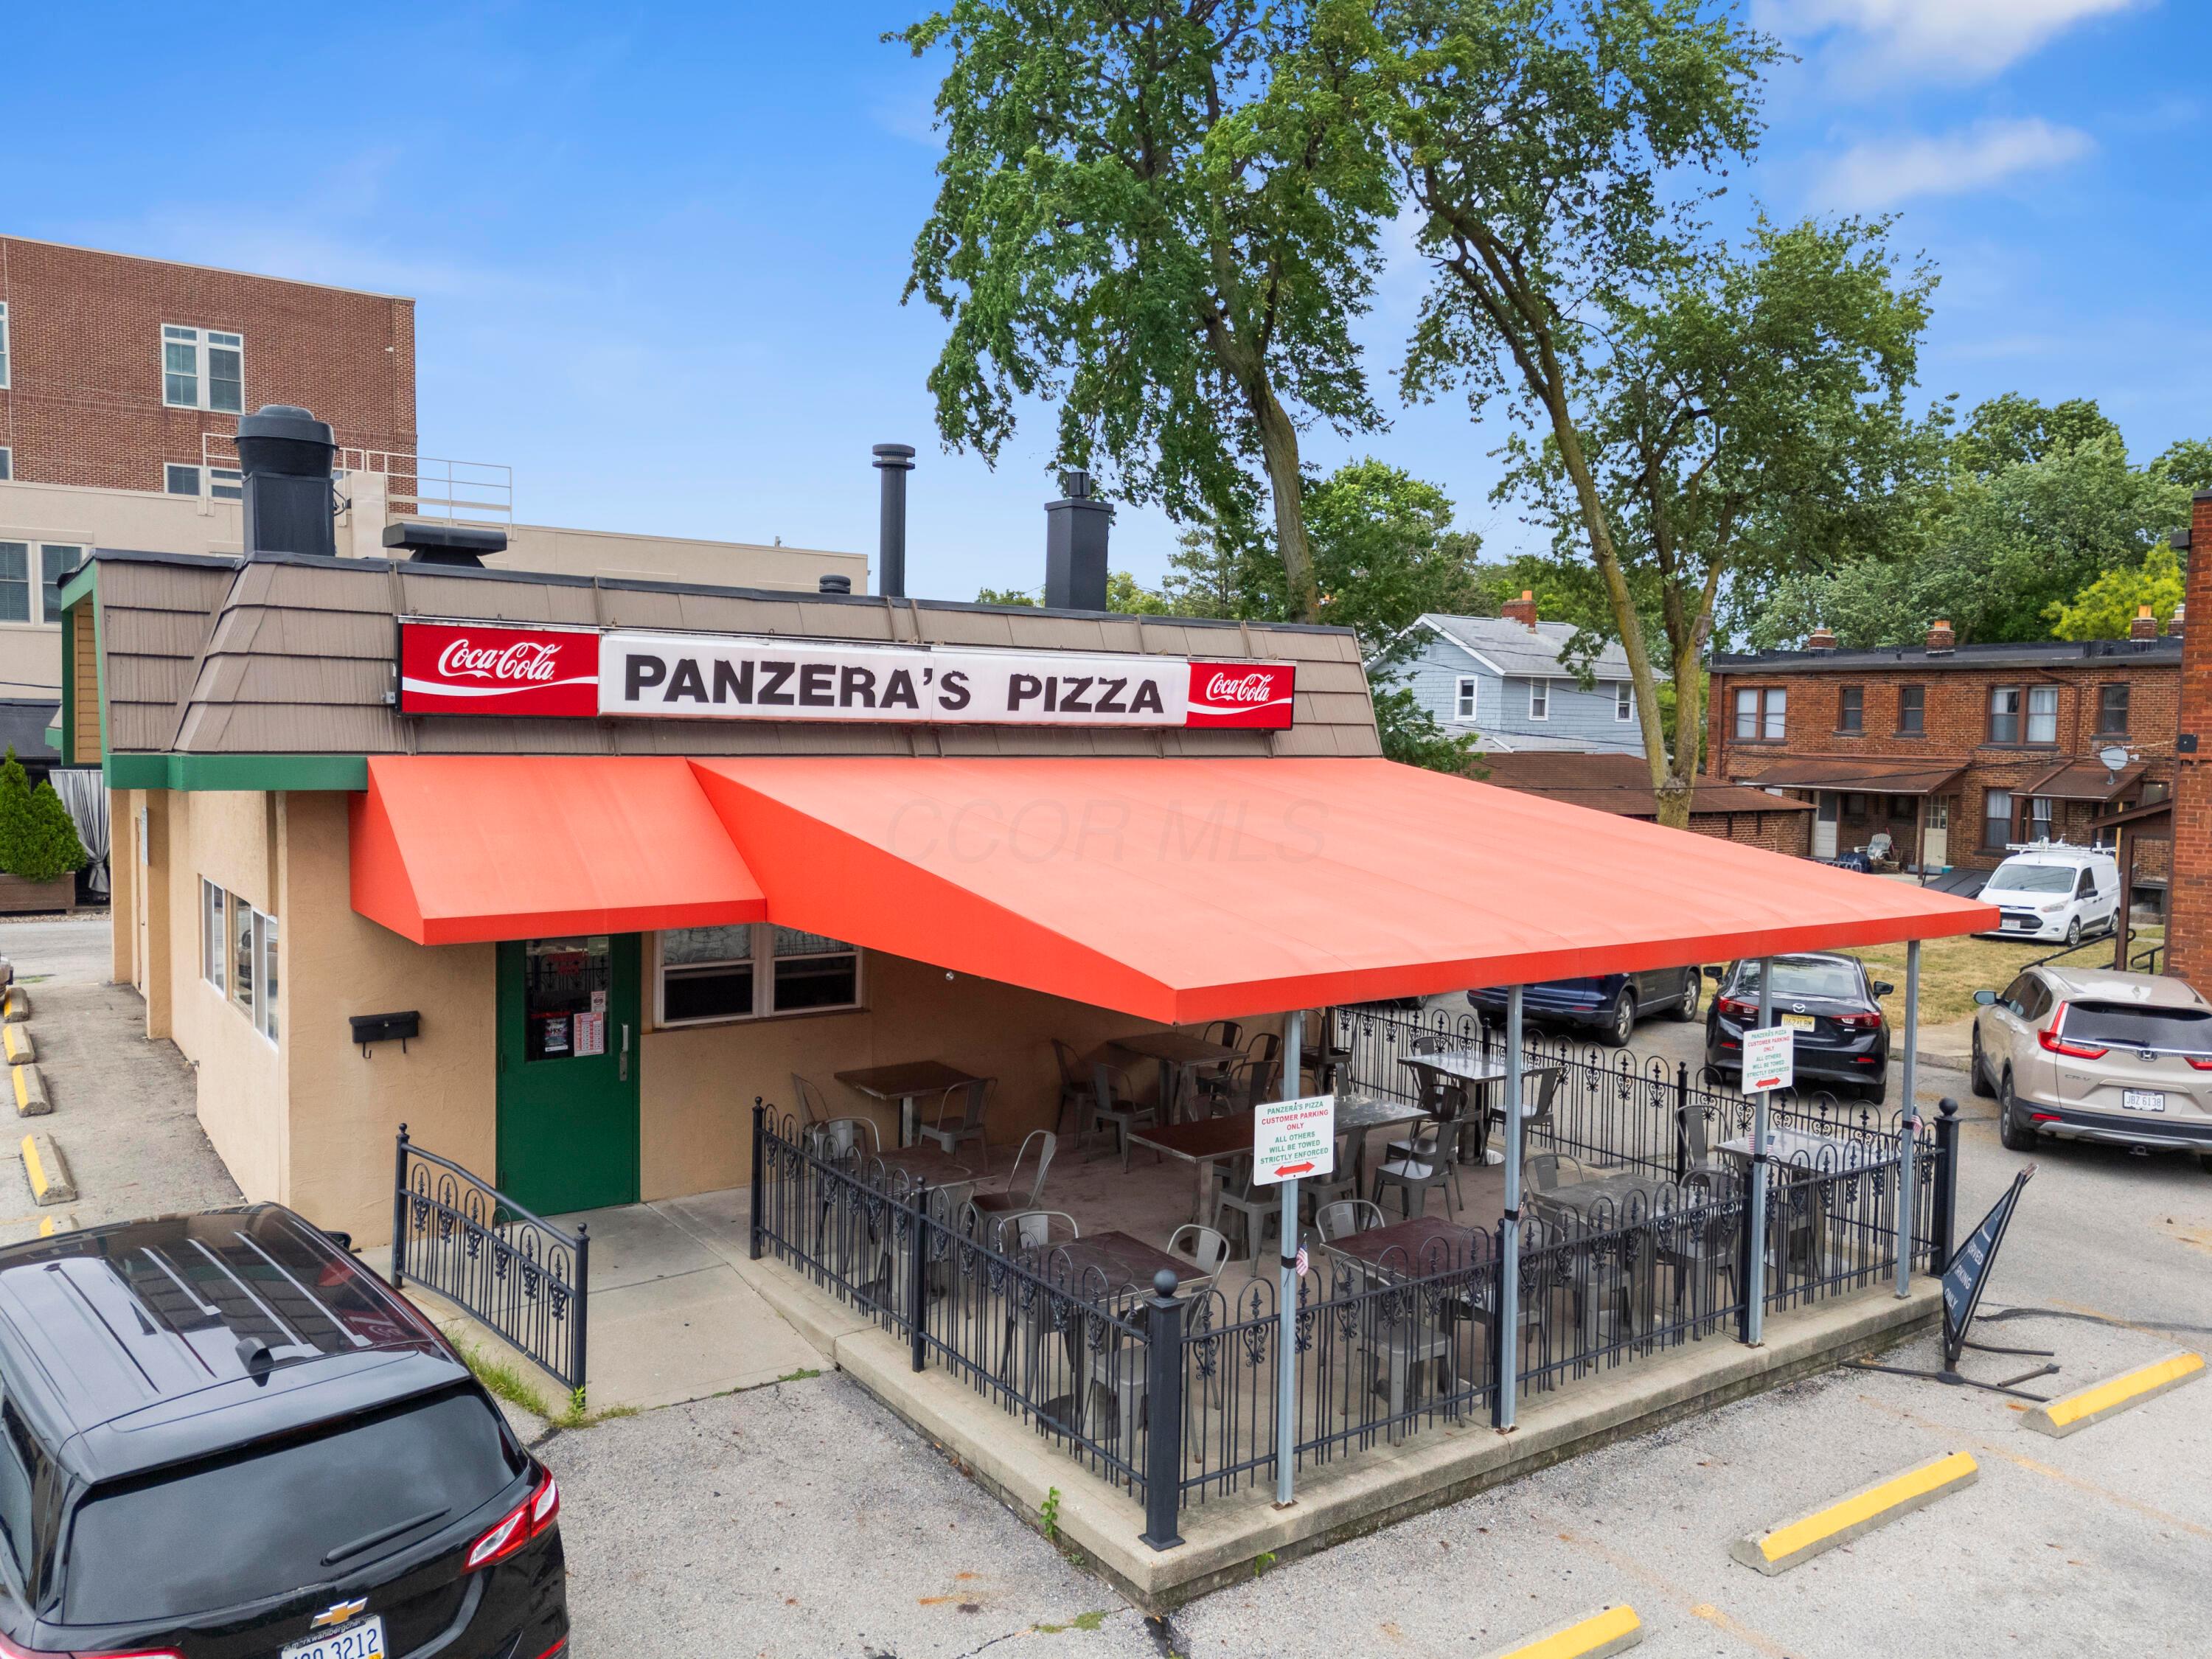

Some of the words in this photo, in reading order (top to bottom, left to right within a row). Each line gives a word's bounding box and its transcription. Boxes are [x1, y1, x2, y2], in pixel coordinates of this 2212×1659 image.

[438, 639, 563, 680] Coca-Cola
[625, 653, 971, 711] PANZERA'S
[1007, 673, 1164, 714] PIZZA
[1206, 672, 1275, 701] Coca-Cola
[1751, 1030, 1774, 1038] PANZERA'S
[1747, 1039, 1770, 1047] CUSTOMER
[1768, 1066, 1790, 1074] ENFORCED
[1267, 1103, 1303, 1115] PANZERA'S
[1304, 1101, 1324, 1110] PIZZA
[1262, 1114, 1298, 1125] CUSTOMER
[1300, 1110, 1329, 1119] PARKING
[1287, 1122, 1304, 1130] ONLY
[1289, 1131, 1315, 1141] OTHERS
[1269, 1145, 1285, 1153] WILL
[1298, 1139, 1321, 1150] TOWED
[1260, 1154, 1293, 1165] STRICTLY
[1294, 1147, 1329, 1159] ENFORCED
[1944, 1288, 1958, 1310] ONLY
[330, 1628, 379, 1659] 3212
